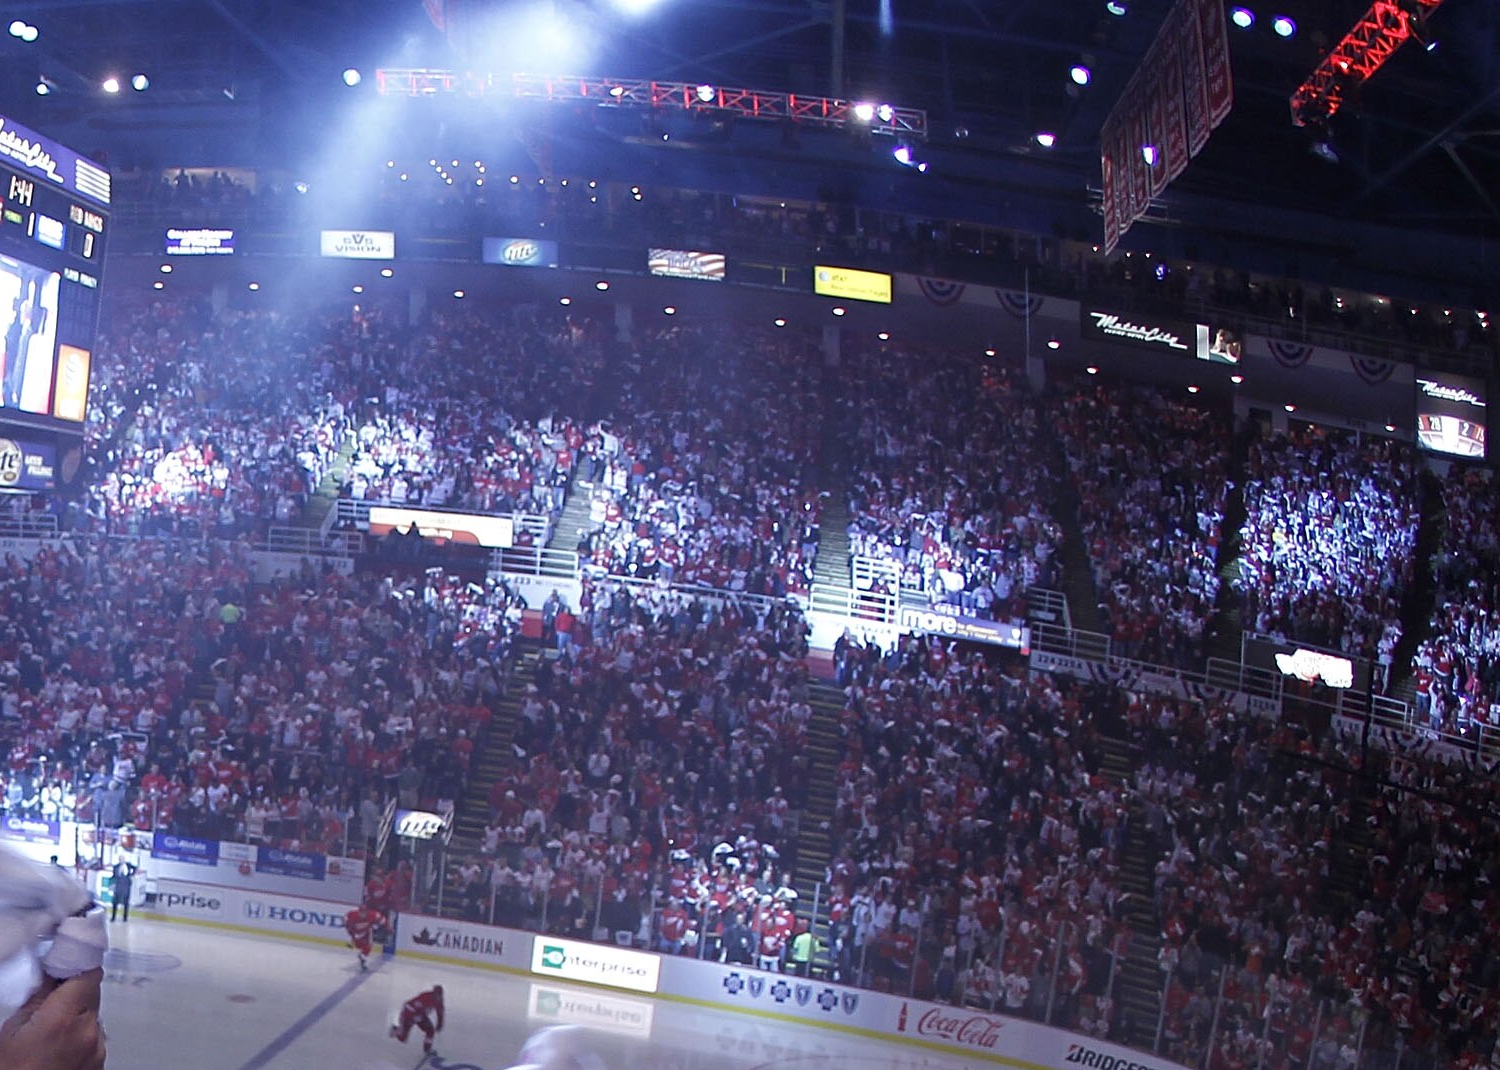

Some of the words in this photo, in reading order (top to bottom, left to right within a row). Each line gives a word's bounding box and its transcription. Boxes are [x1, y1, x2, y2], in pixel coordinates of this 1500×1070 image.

[902, 609, 957, 634] more
[156, 891, 222, 910] rprise
[268, 907, 347, 928] HOND
[435, 931, 503, 955] CANADIAN
[917, 1006, 1004, 1049] Coca-Cola
